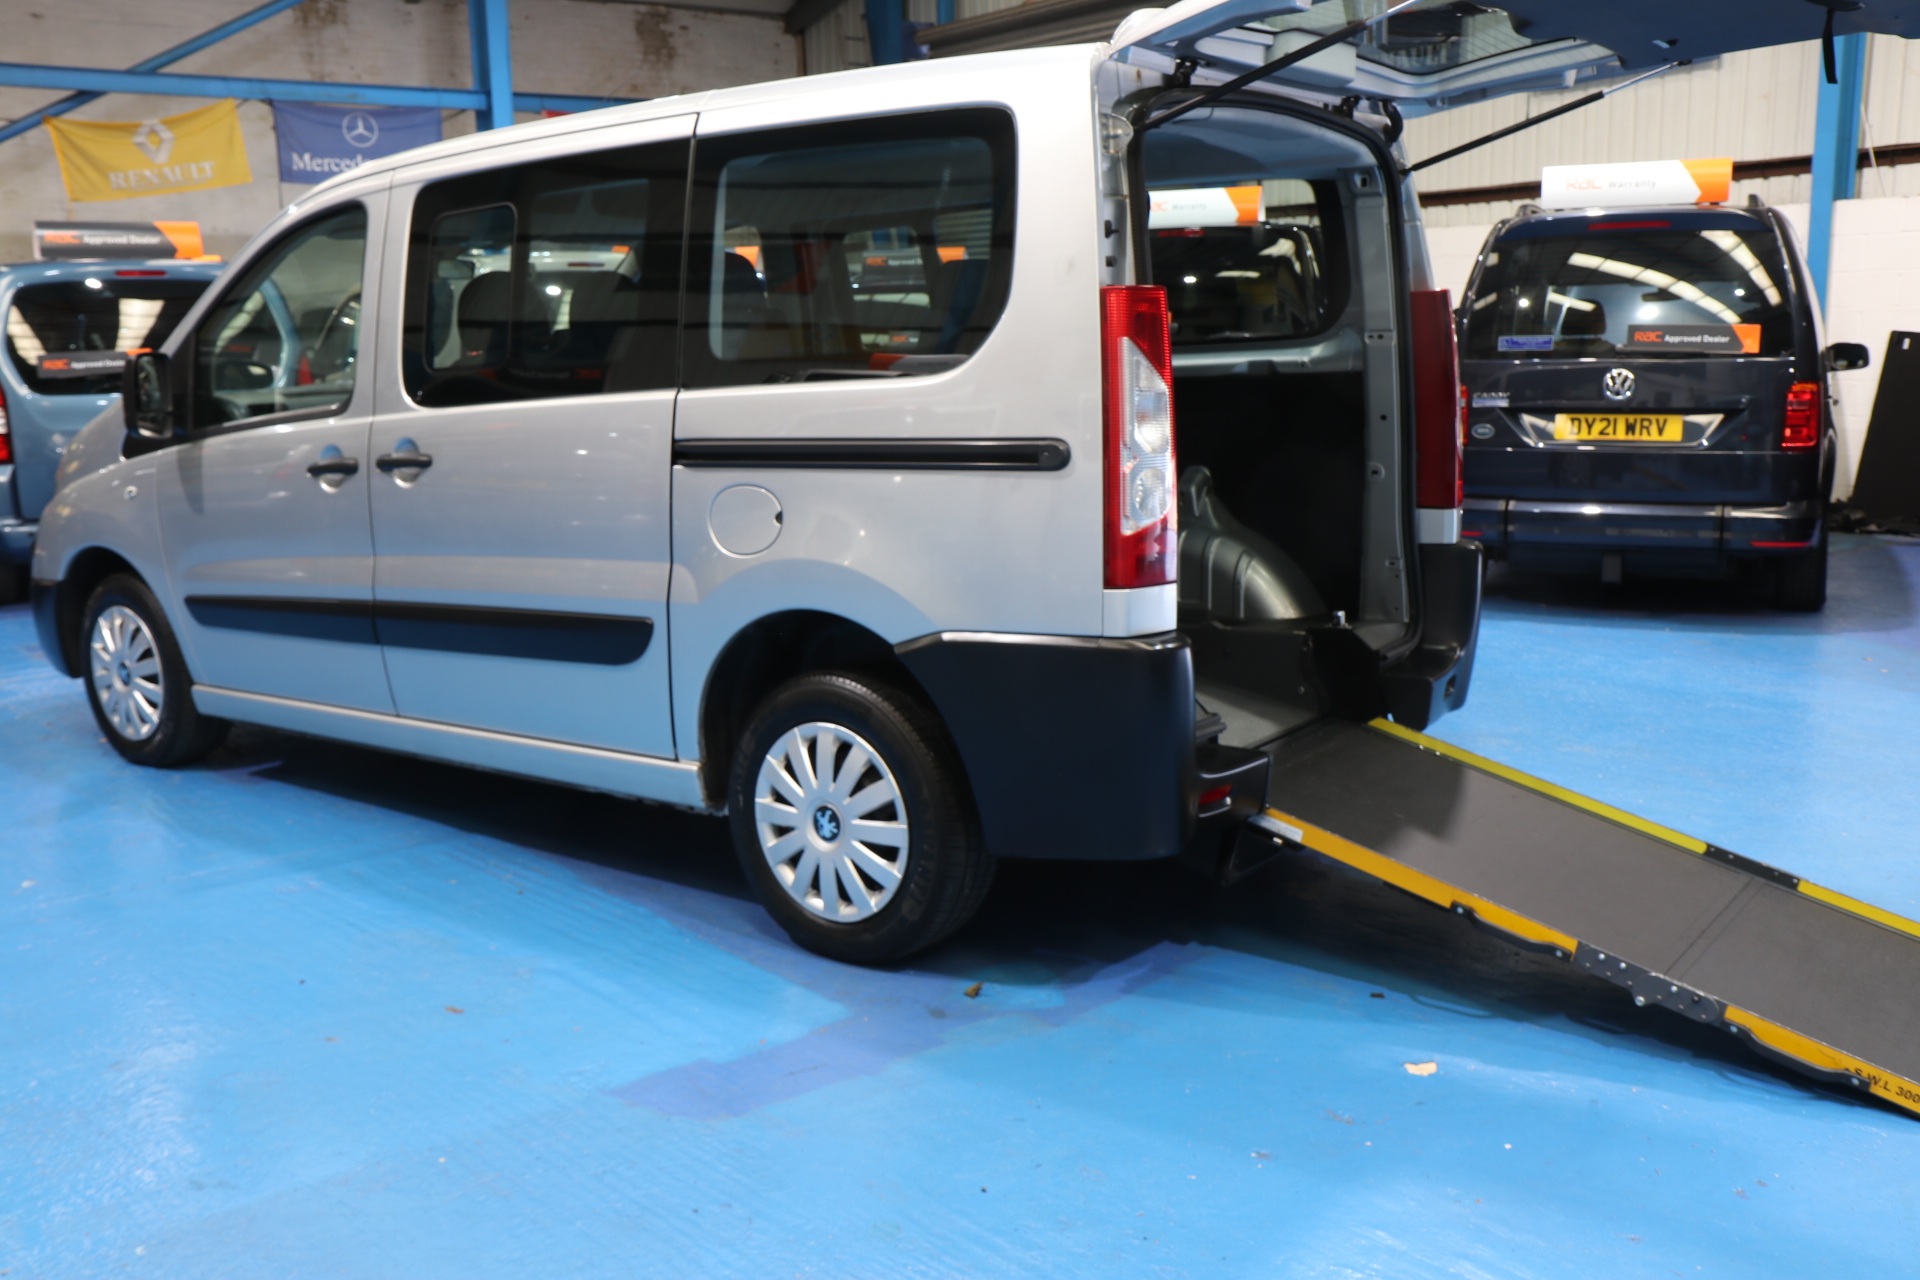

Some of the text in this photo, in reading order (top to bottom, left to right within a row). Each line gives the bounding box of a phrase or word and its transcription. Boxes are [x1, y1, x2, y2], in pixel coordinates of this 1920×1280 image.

[291, 151, 371, 173] Merced
[107, 161, 215, 190] RENAULT
[1607, 179, 1657, 190] Warranty
[1149, 201, 1169, 212] AC
[82, 234, 127, 246] Approved
[128, 234, 161, 245] Dealer
[1634, 331, 1731, 344] RAC Approved Dealer
[1570, 416, 1668, 437] DY21 WRV
[1895, 1085, 1920, 1104] 300
